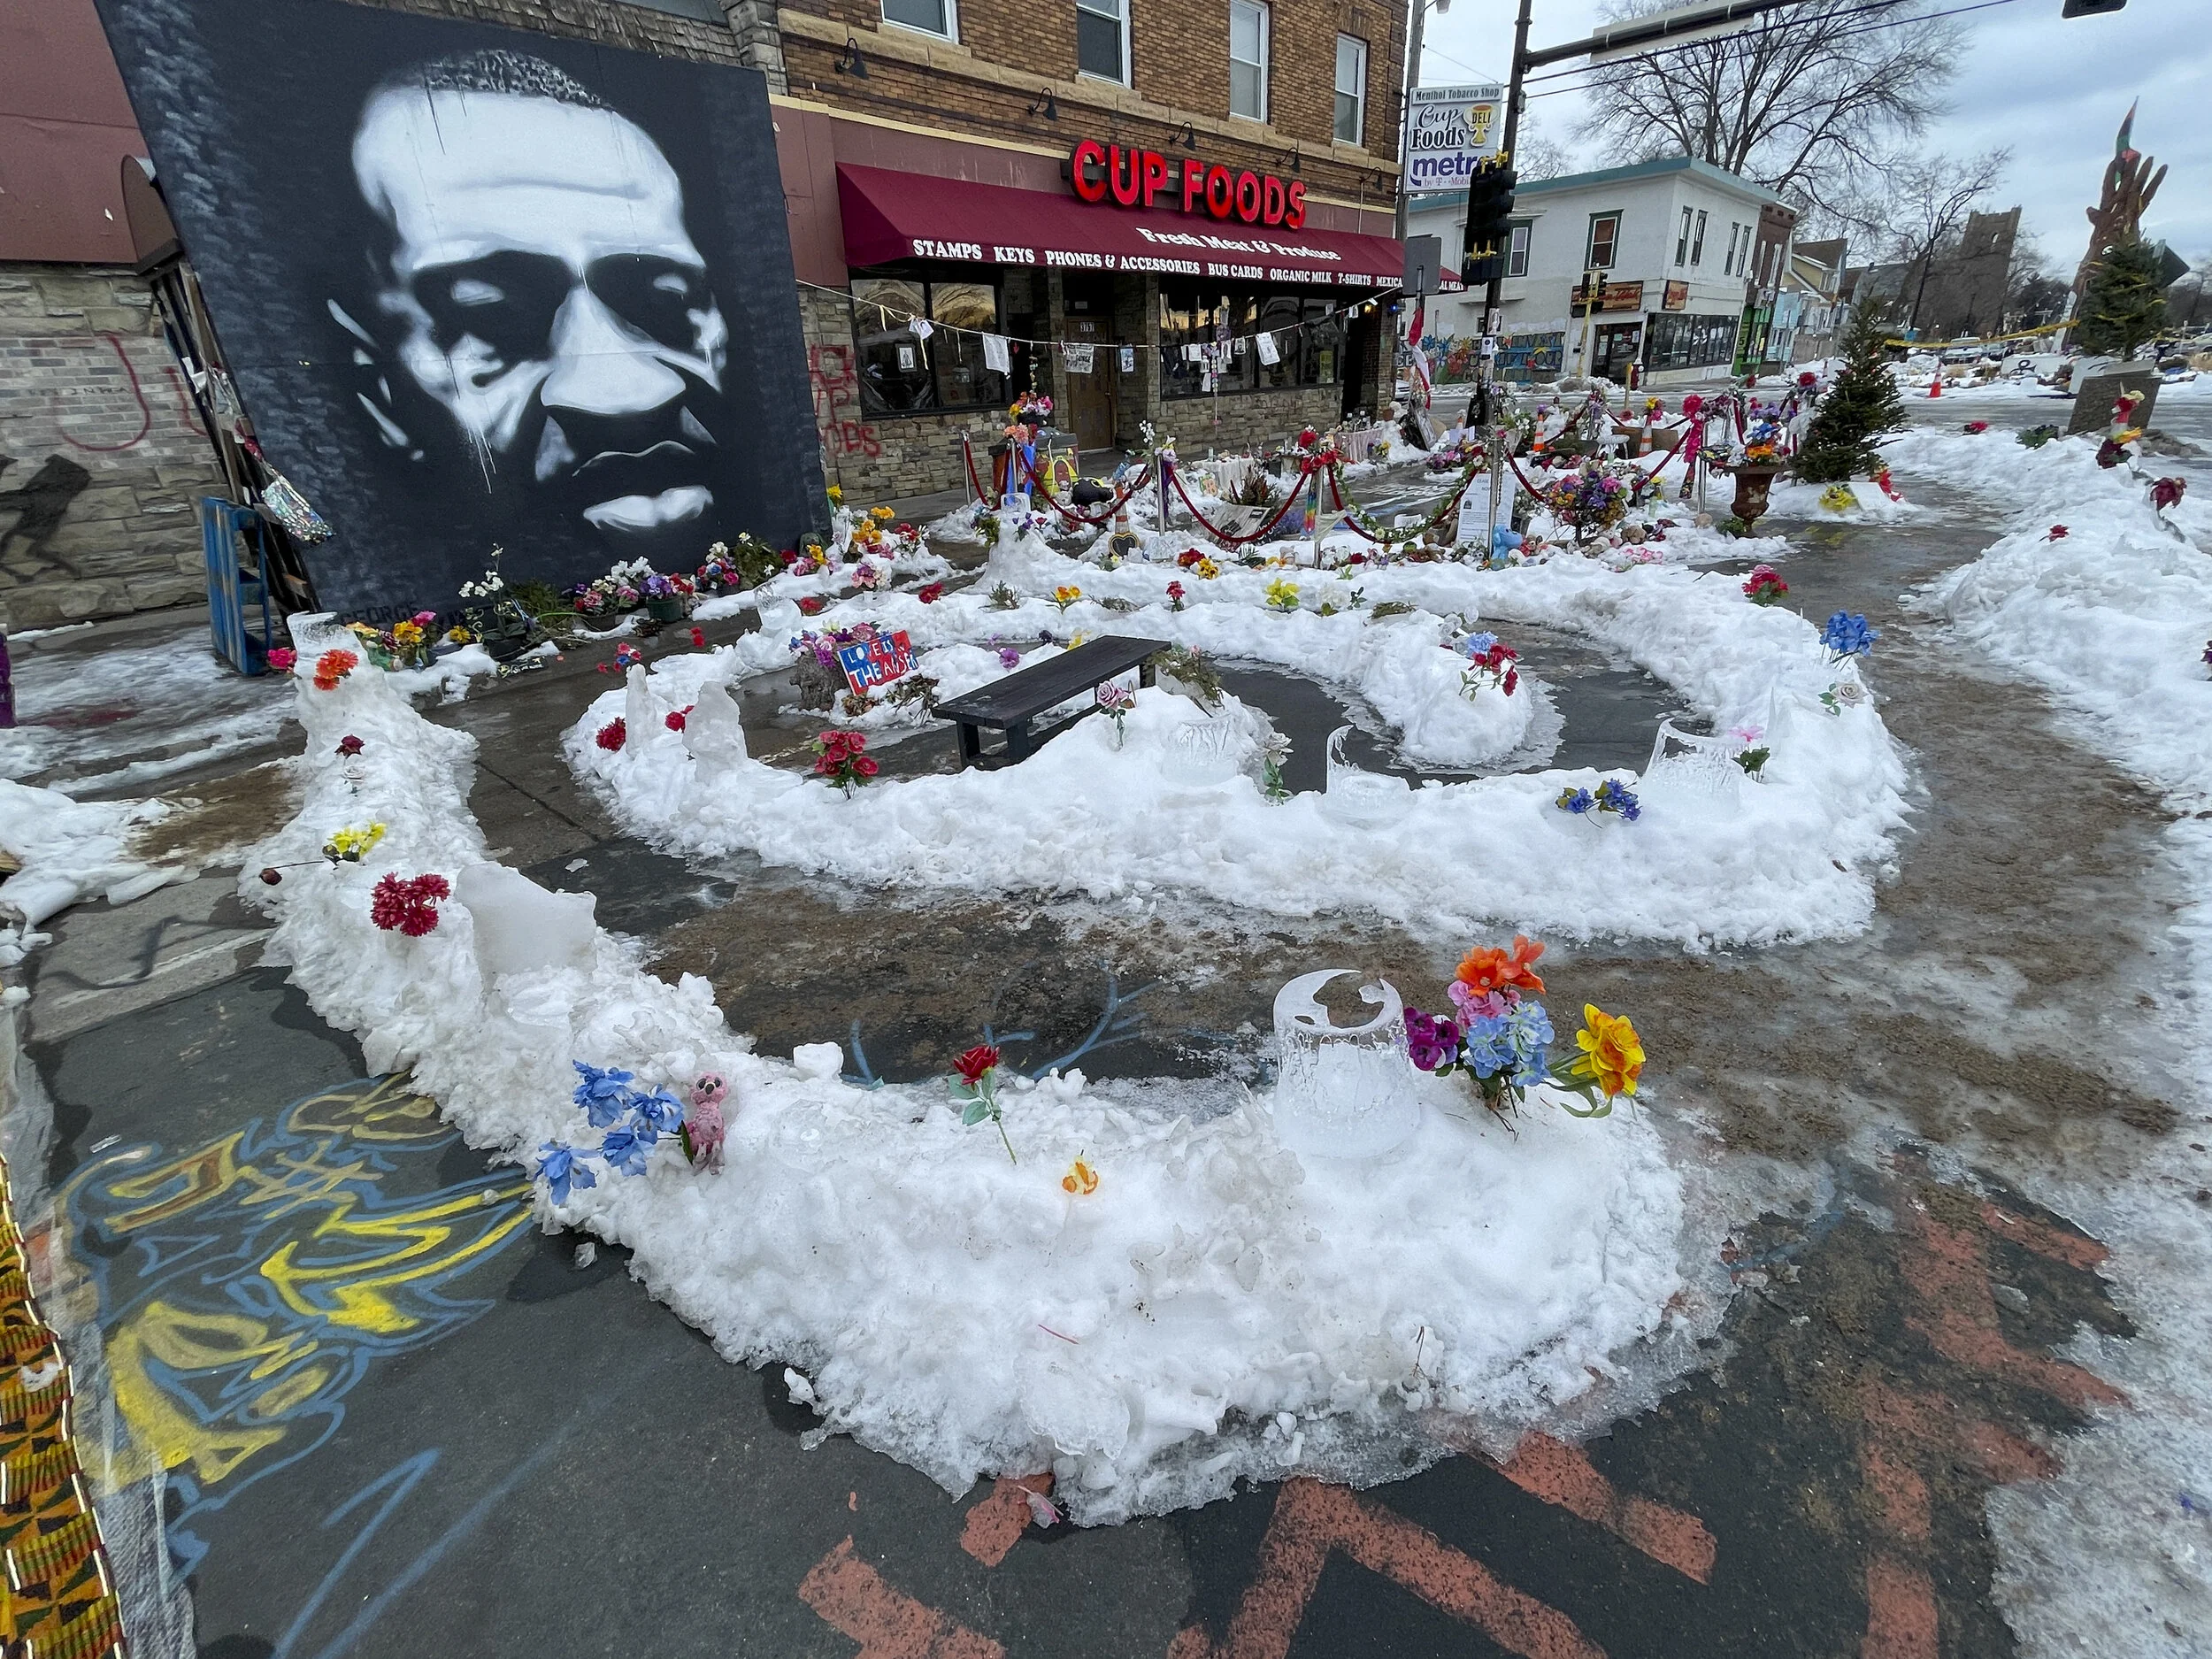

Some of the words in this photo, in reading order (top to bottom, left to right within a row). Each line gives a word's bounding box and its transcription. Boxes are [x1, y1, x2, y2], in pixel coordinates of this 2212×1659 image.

[1416, 89, 1446, 101] Menthol
[1448, 88, 1479, 99] Tobacco
[1481, 88, 1499, 98] Shop
[1417, 104, 1462, 130] Cup
[1472, 111, 1491, 124] DELI
[1411, 127, 1465, 149] Foods
[1412, 151, 1479, 177] metr
[1071, 139, 1169, 207] CUP
[1181, 158, 1307, 230] FOODS
[1135, 227, 1206, 248] Fresh
[1200, 234, 1256, 252] Meat
[1269, 242, 1341, 261] Produce
[912, 239, 983, 260] STAMPS
[993, 246, 1035, 264] KEYS
[1044, 250, 1102, 268] PHONES
[1104, 254, 1115, 269] &
[1119, 256, 1201, 275] ACCESSORIES
[1207, 262, 1229, 278] BUS
[1231, 265, 1263, 280] CARDS
[1270, 267, 1310, 283] ORGANIC
[1311, 271, 1333, 284] MILK
[1338, 273, 1371, 286] T-SHIRTS
[1376, 276, 1403, 288] MEXICA
[847, 642, 880, 664] LOVE
[882, 639, 894, 653] IS
[849, 661, 882, 688] THE
